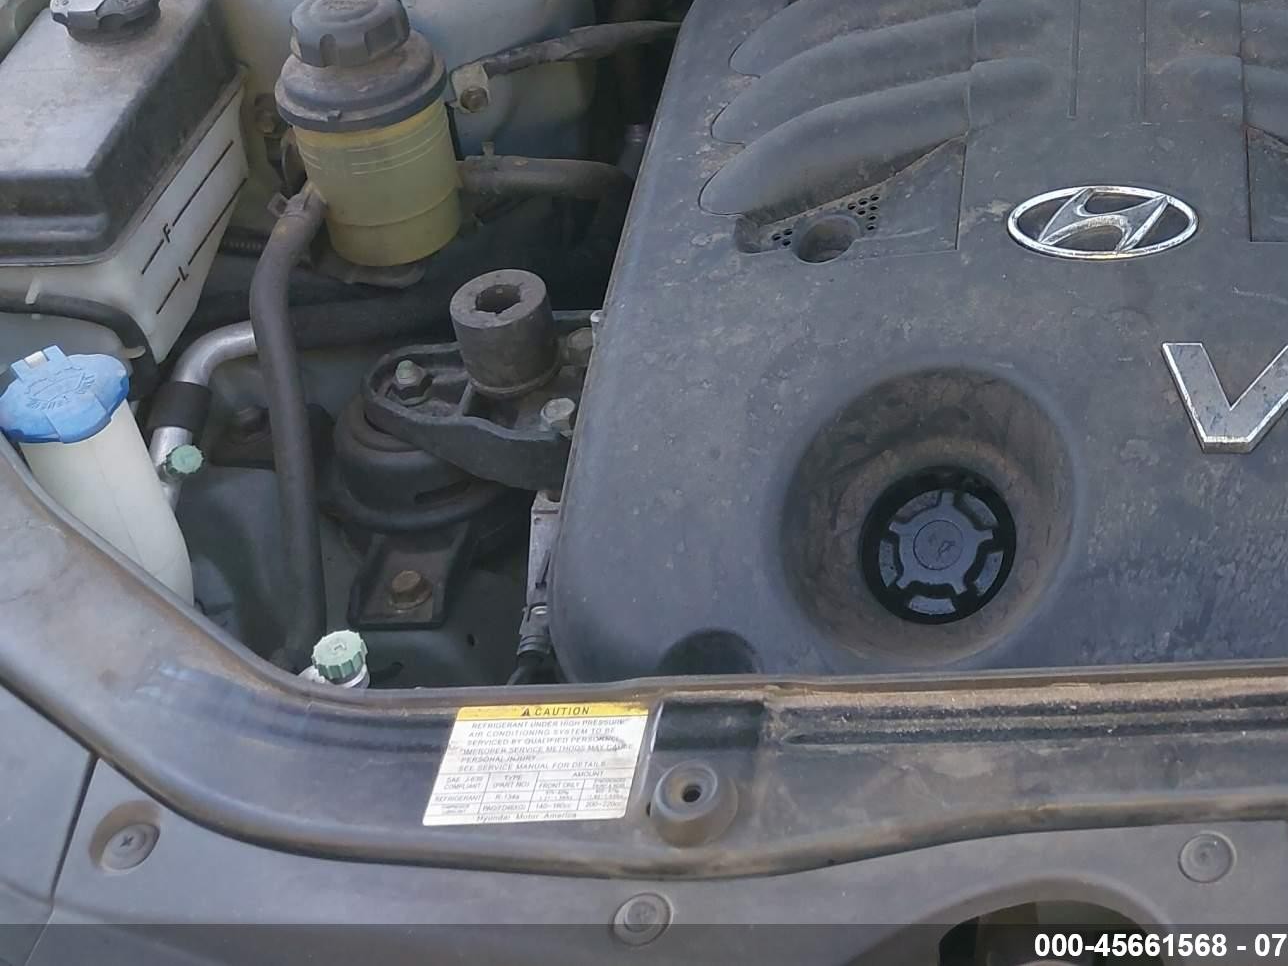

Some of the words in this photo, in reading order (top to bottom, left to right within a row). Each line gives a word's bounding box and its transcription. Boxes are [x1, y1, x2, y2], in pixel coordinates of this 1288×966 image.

[163, 223, 171, 243] F
[179, 266, 189, 281] L
[535, 707, 590, 716] CAUTION
[472, 721, 528, 729] REFRIGERANT
[486, 729, 550, 737] CONDITIONING
[516, 762, 548, 770] MANUAL
